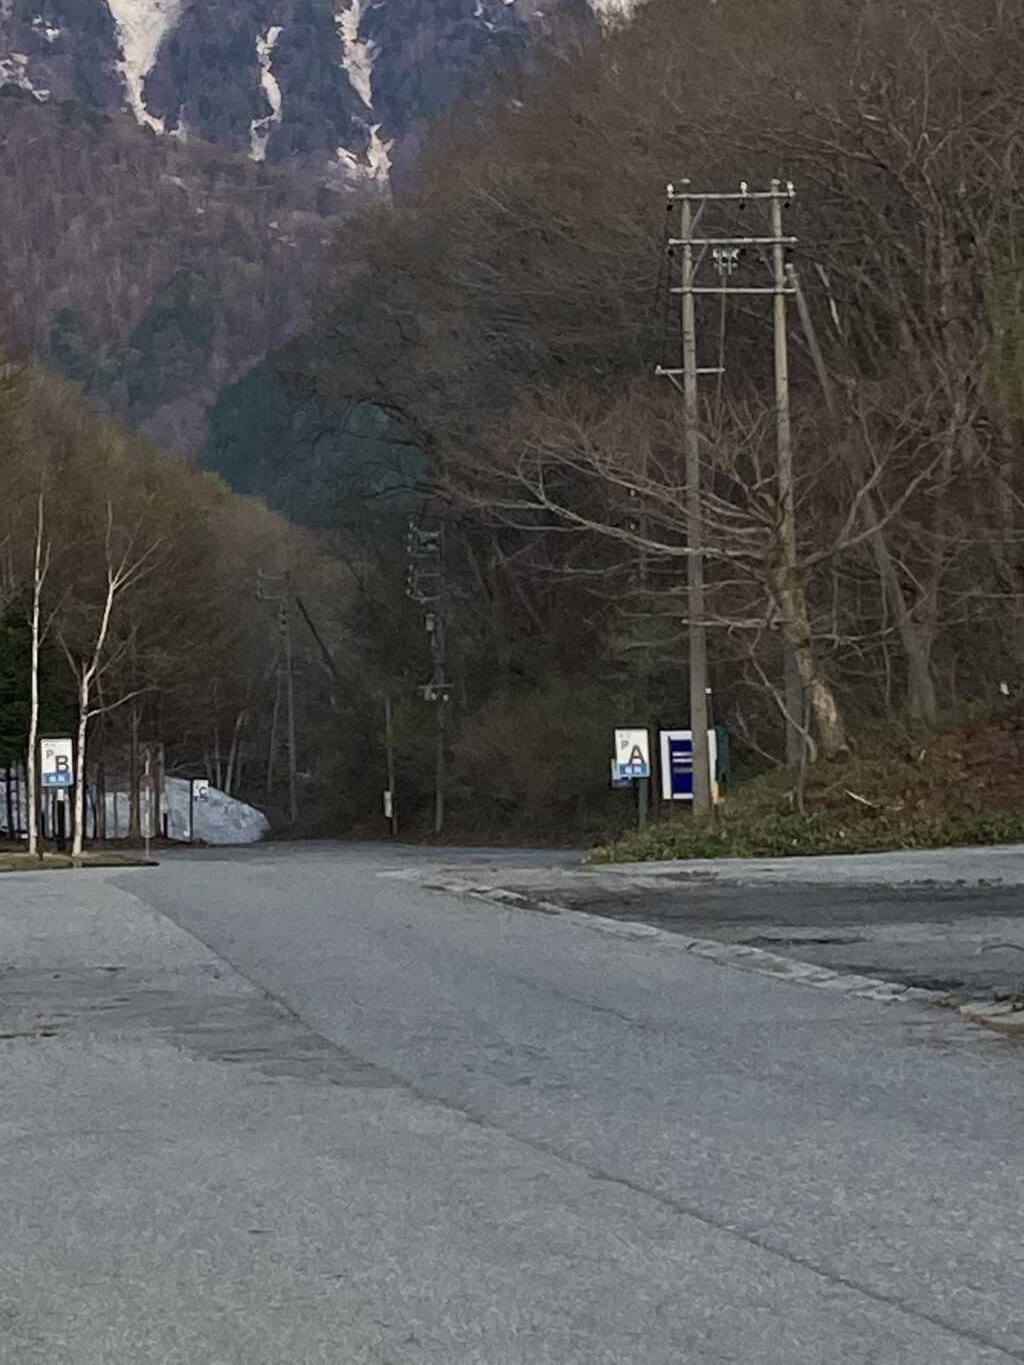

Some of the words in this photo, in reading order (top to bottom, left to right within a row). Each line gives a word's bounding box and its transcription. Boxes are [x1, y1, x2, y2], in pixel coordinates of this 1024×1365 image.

[46, 749, 54, 759] P
[629, 744, 645, 764] A
[56, 755, 69, 773] B
